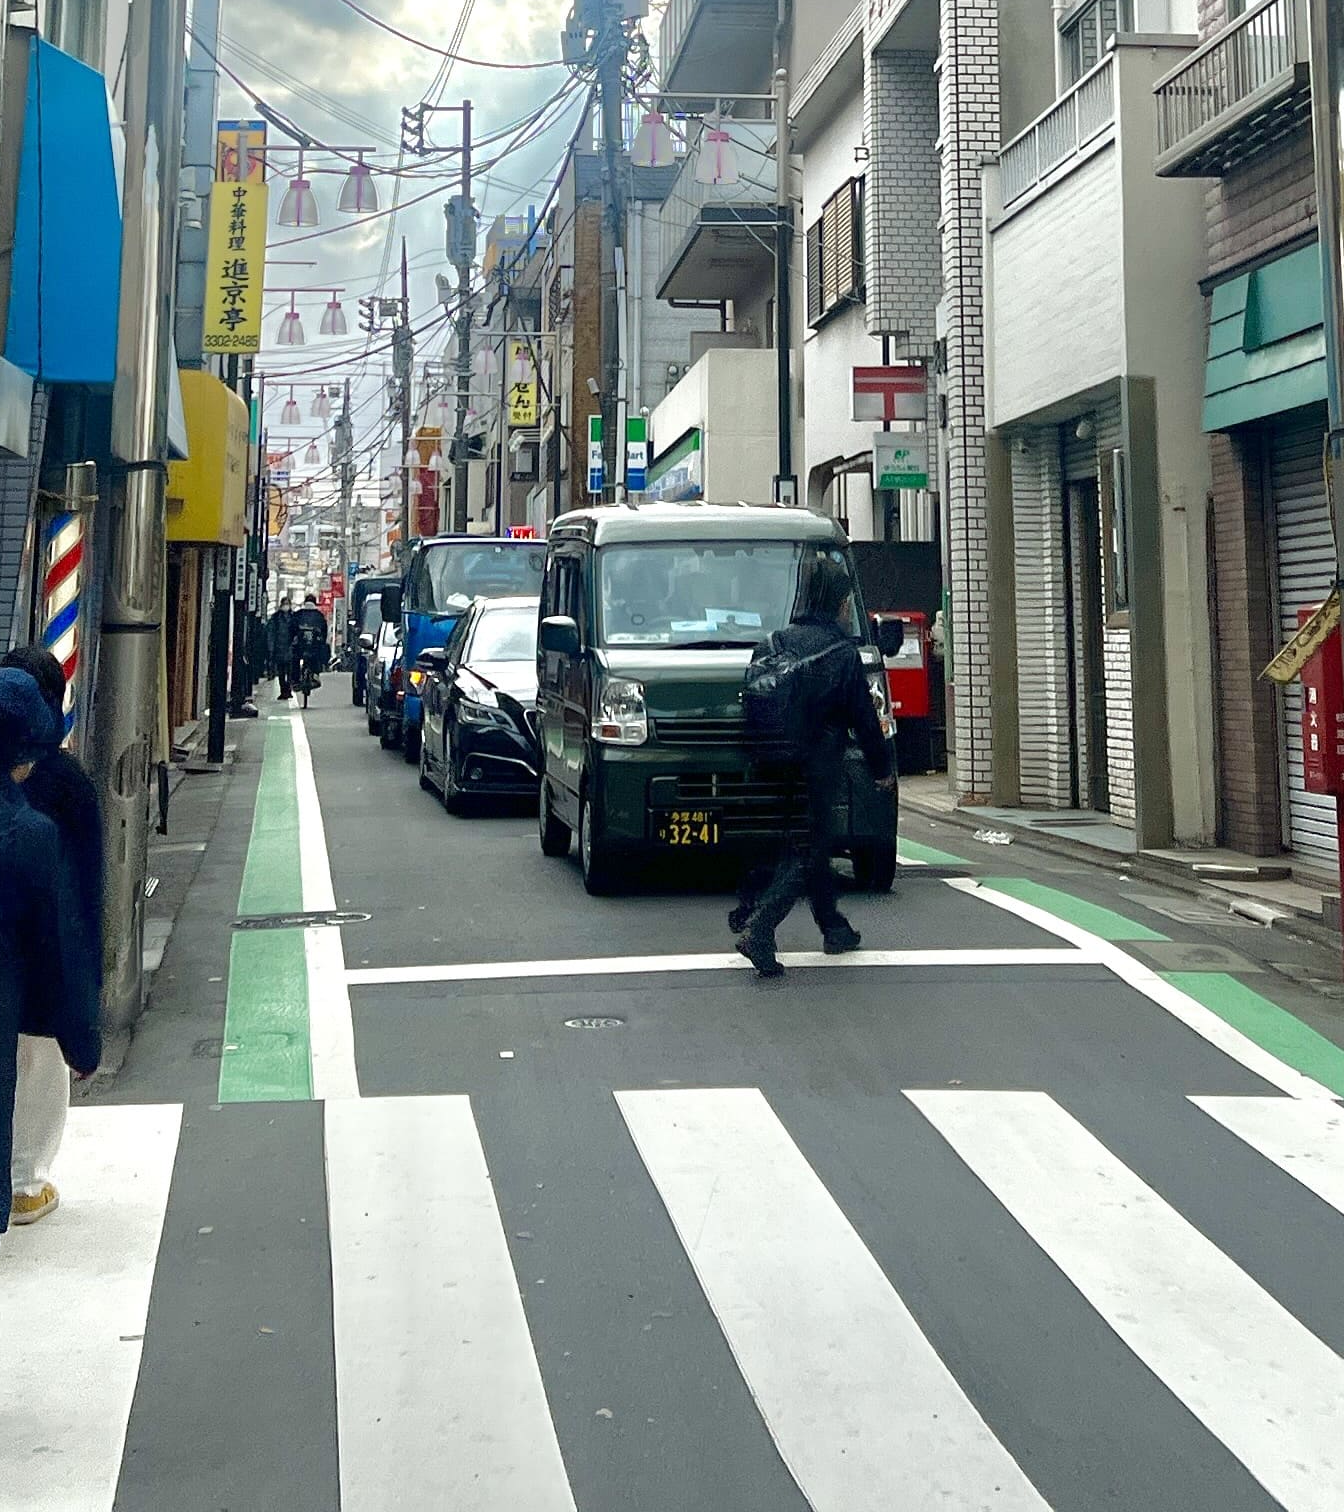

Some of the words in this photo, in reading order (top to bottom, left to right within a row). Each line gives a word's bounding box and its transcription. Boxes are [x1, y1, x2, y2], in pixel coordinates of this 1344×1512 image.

[227, 186, 248, 251] 中華料理
[218, 259, 250, 332] 進京亭
[669, 824, 718, 844] 32-41
